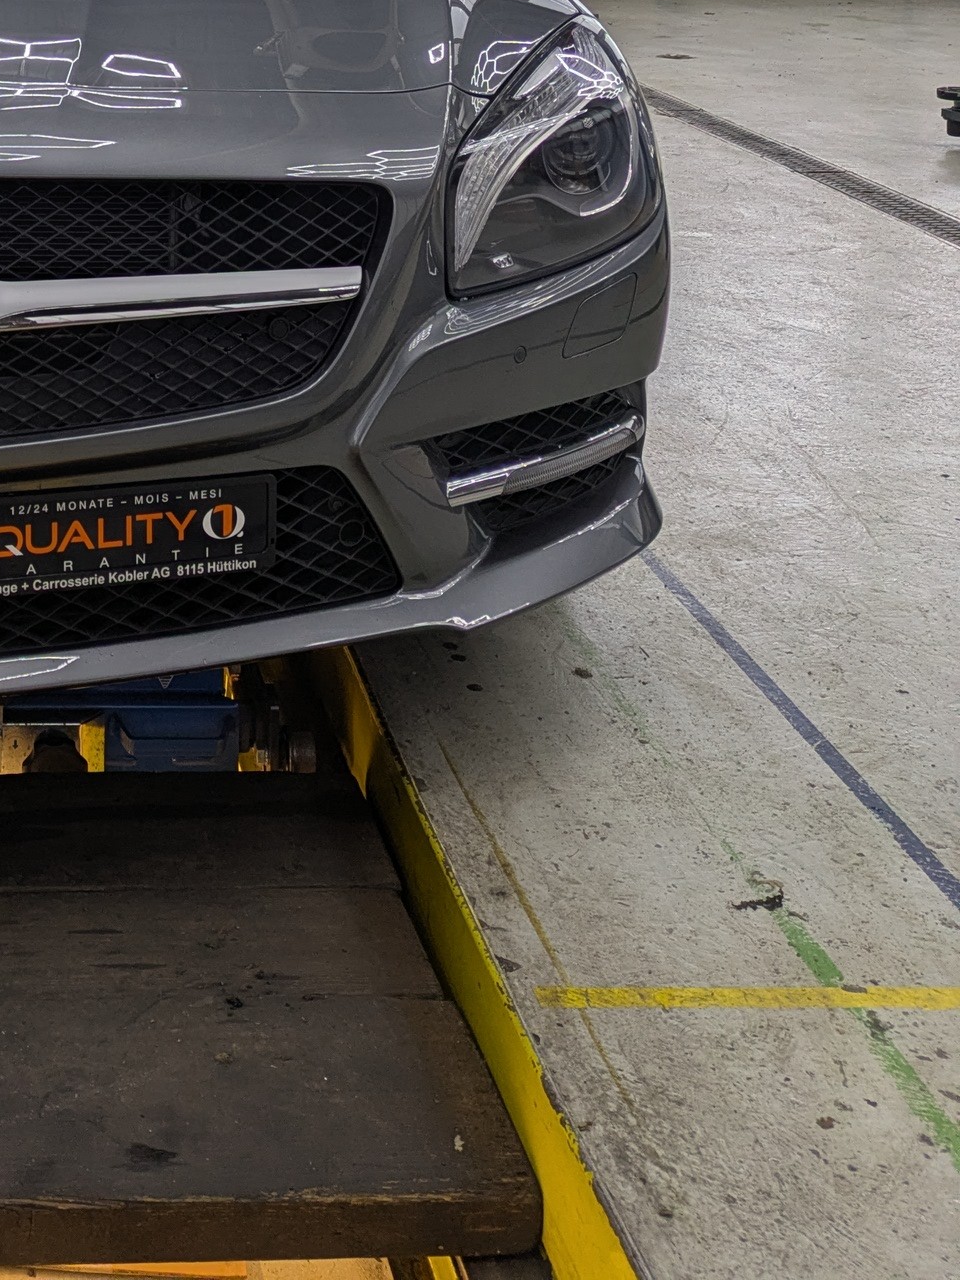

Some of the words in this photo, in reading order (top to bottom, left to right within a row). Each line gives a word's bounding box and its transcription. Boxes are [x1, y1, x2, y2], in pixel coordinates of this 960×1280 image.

[9, 503, 49, 516] 12/24
[56, 498, 114, 512] MONATE
[134, 493, 169, 505] MOIS
[189, 489, 222, 500] MESI
[32, 574, 105, 591] Carrosserie
[108, 570, 148, 583] Kobler
[151, 567, 171, 579] AG
[176, 563, 205, 577] 8115
[207, 559, 257, 573] Hüttikon
